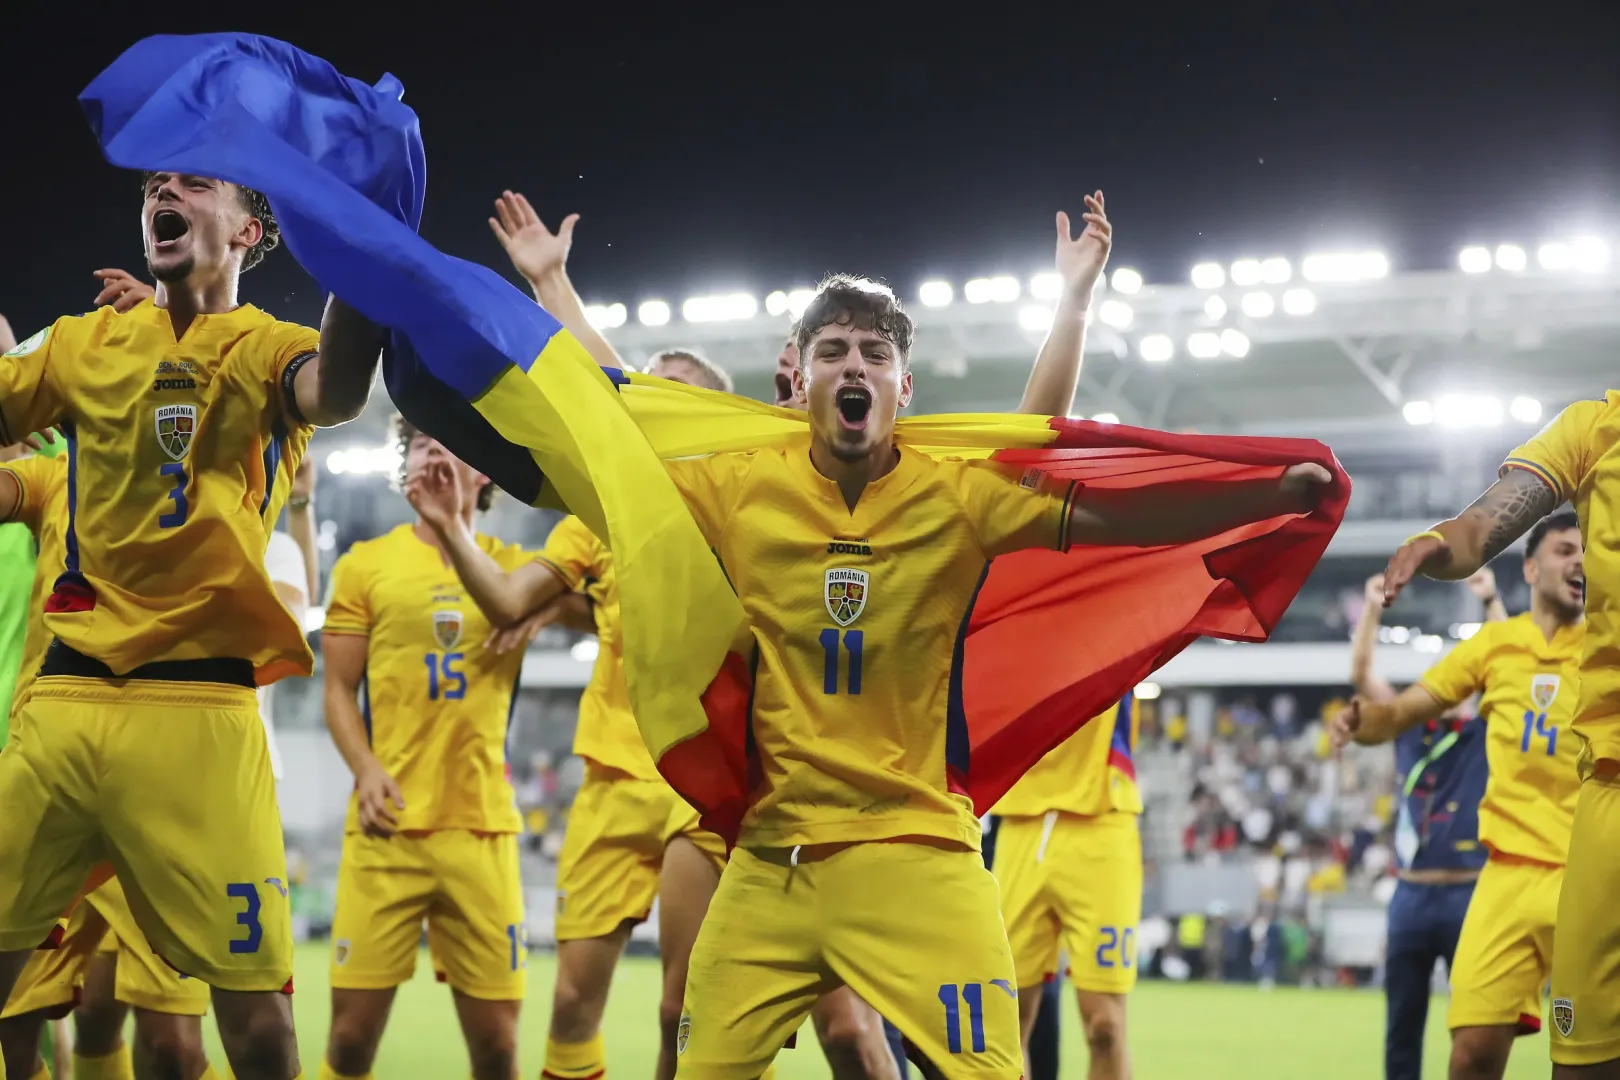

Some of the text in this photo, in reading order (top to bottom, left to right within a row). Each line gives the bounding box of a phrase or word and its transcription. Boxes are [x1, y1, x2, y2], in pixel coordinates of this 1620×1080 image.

[158, 405, 193, 418] ROMÂNIA
[159, 462, 189, 528] 3
[829, 570, 865, 584] ROMÂNIA
[424, 652, 468, 701] 15
[819, 628, 864, 695] 11
[1521, 709, 1558, 756] 14
[226, 883, 262, 953] 3
[938, 983, 986, 1053] 11
